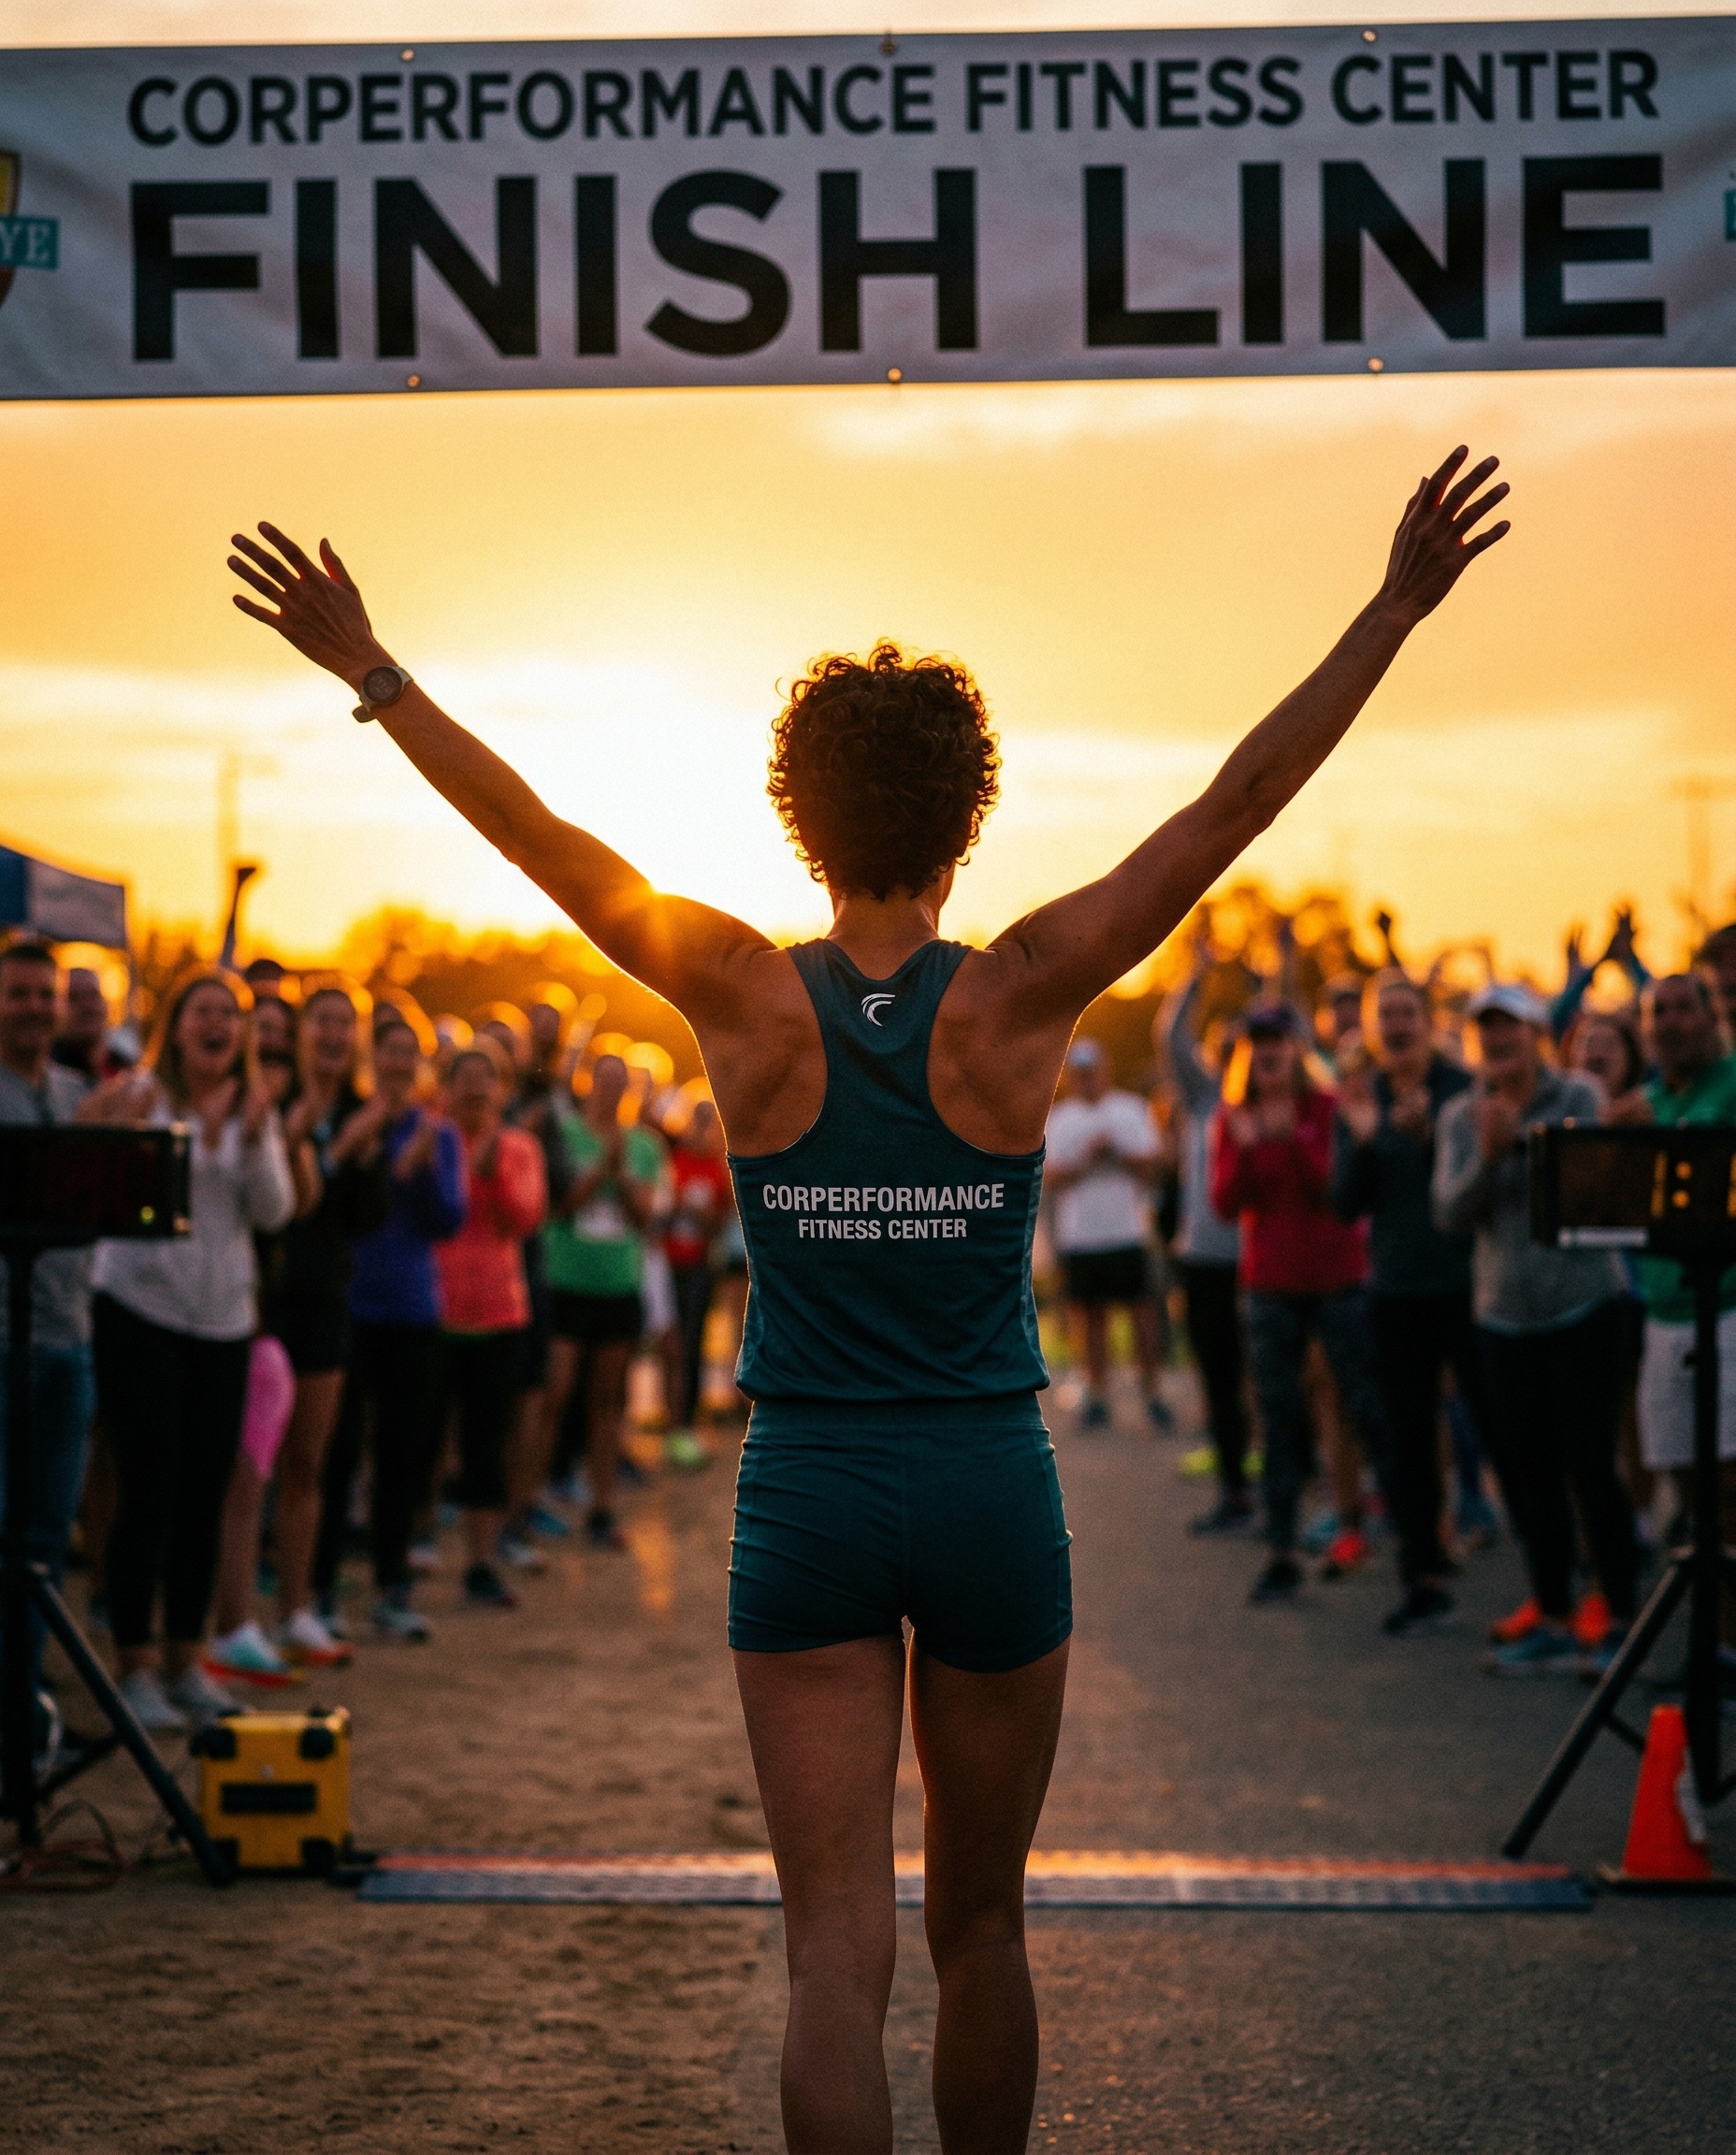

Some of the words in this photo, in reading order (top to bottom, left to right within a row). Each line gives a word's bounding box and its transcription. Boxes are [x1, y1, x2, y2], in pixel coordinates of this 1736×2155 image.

[126, 65, 936, 148] CORPERFORMANCE
[965, 56, 1304, 133] FITNESS
[1330, 49, 1661, 126] CENTER
[128, 167, 979, 363] FINISH
[1082, 152, 1668, 349] LINE
[761, 1182, 1005, 1213] CORPERFORMANCE
[798, 1218, 882, 1240] FITNESS
[887, 1218, 968, 1239] CENTER
